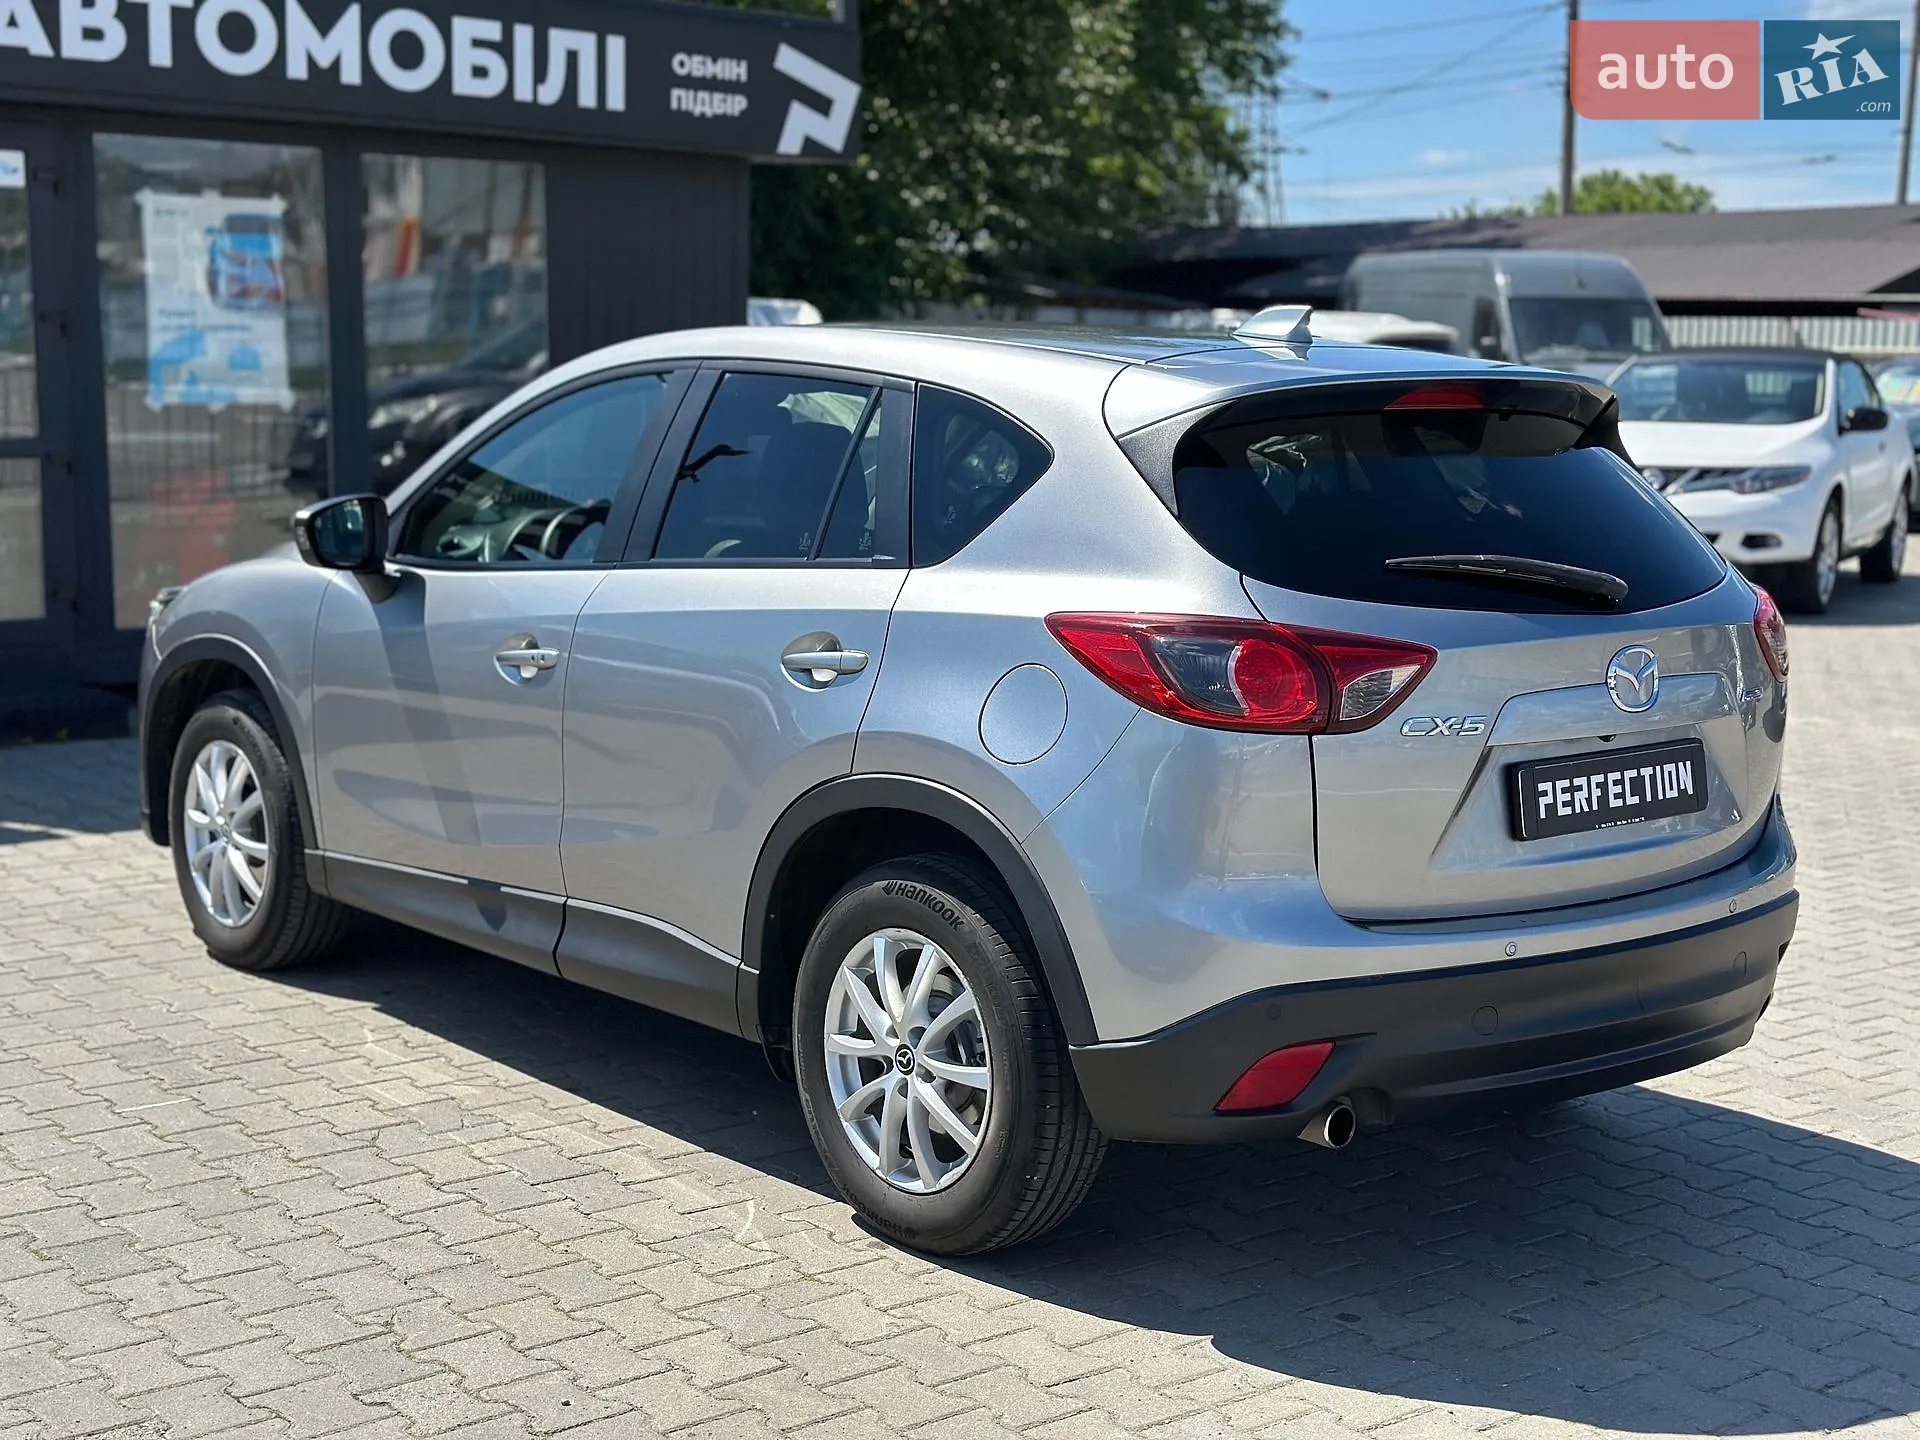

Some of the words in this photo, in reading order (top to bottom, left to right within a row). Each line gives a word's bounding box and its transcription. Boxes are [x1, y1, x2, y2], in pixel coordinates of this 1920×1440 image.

[671, 52, 749, 83] ОБМІН
[669, 87, 749, 118] ПІДБІР
[1400, 714, 1488, 737] CX-5
[1537, 760, 1694, 820] PERFECTION
